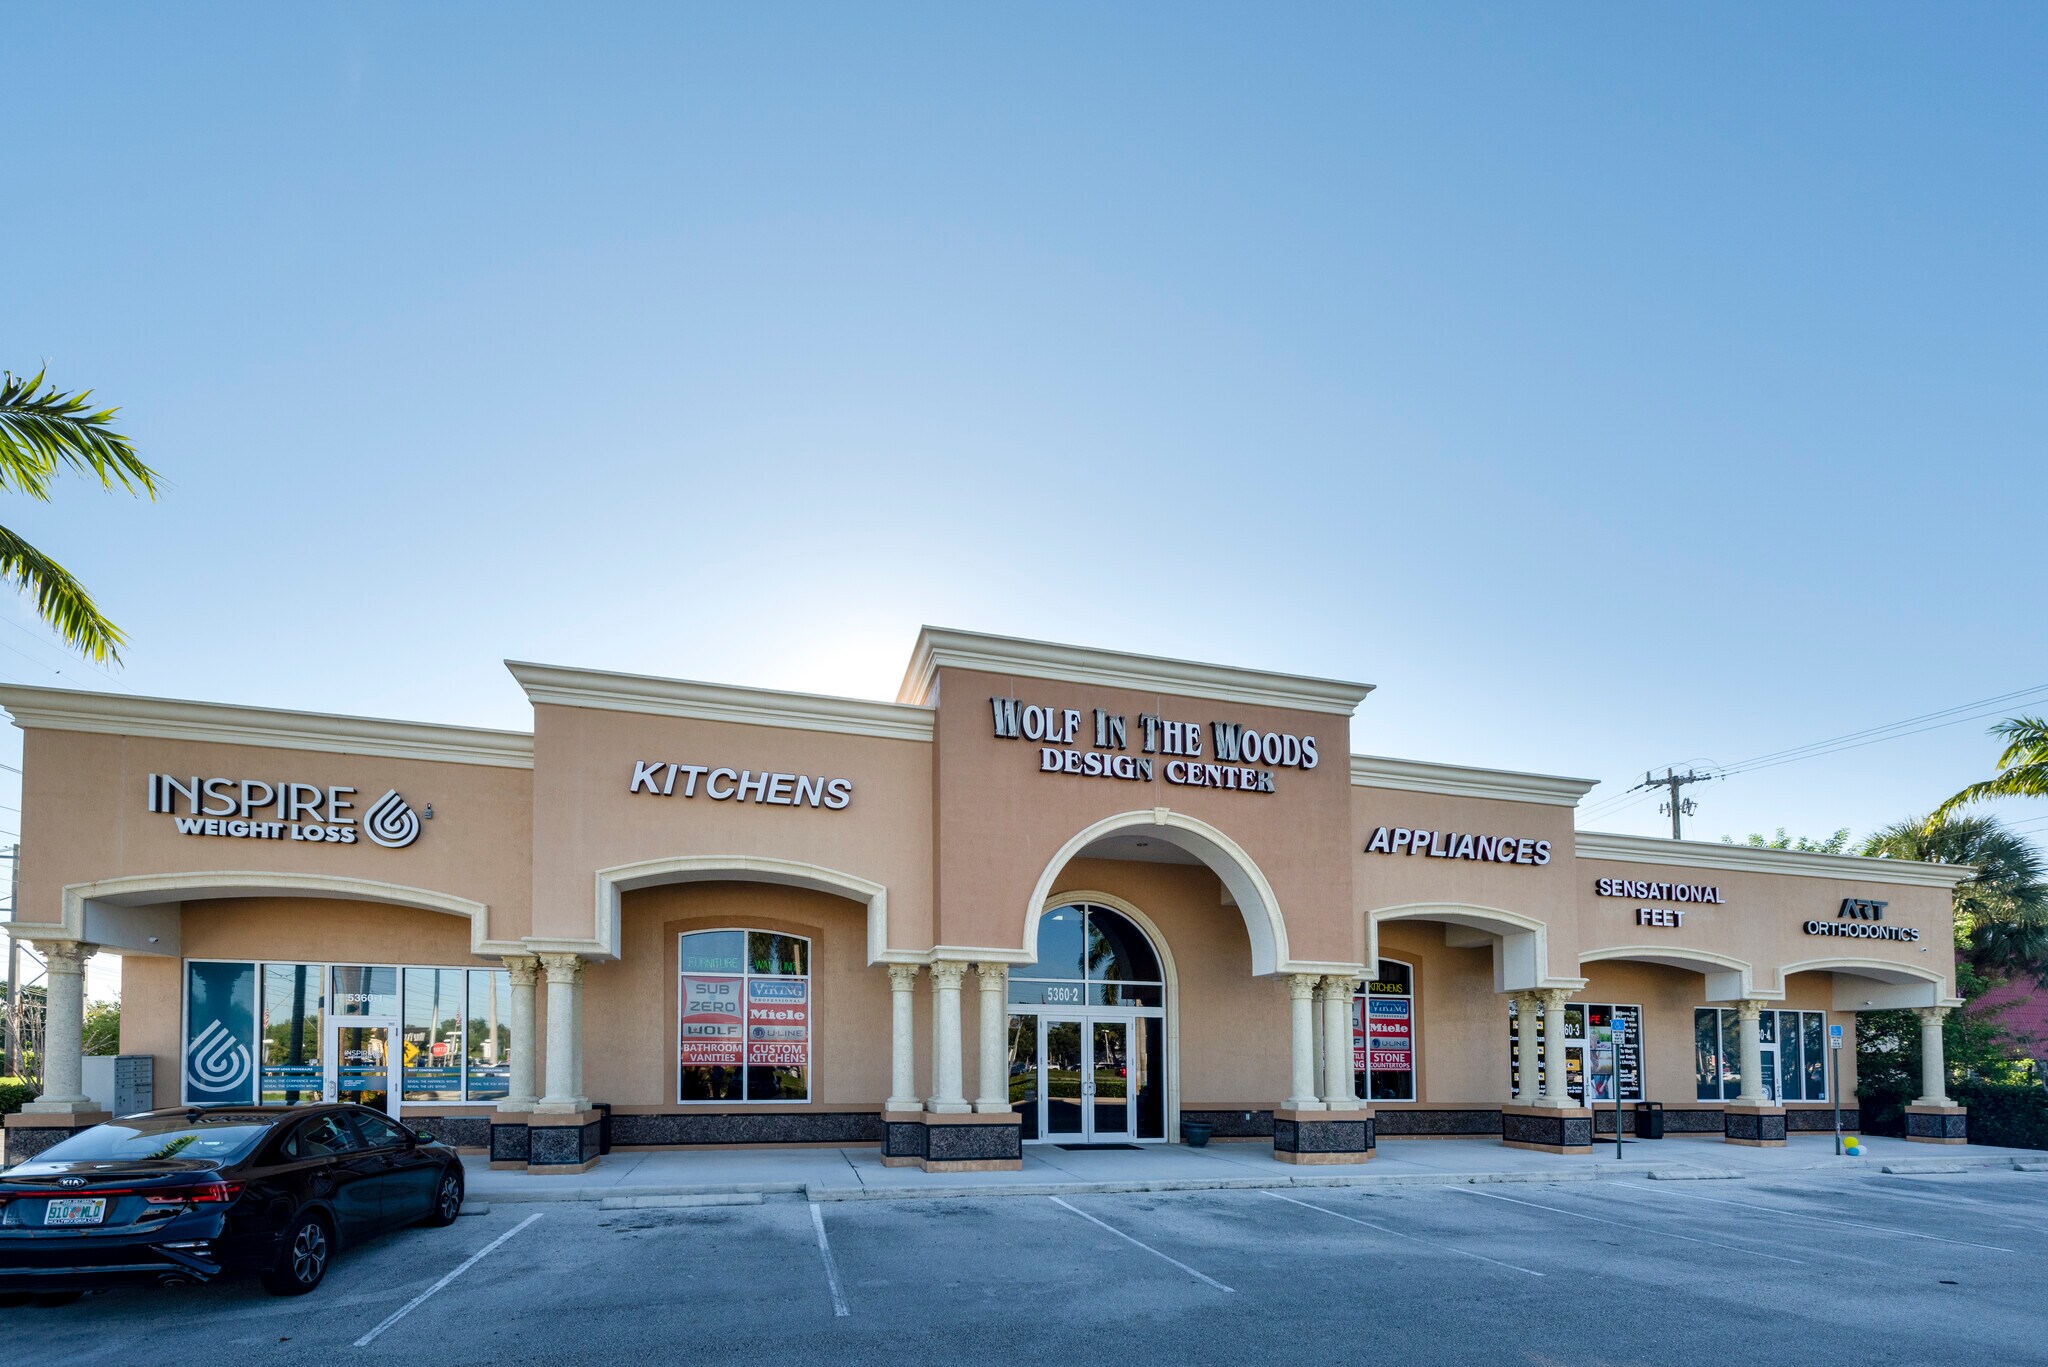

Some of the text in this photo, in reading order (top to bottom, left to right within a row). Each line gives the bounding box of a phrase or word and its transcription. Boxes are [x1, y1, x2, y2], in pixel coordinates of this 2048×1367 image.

[990, 697, 1319, 770] WOLF IN THE WOODS
[1040, 747, 1276, 794] DESIGN CENTER
[630, 760, 852, 810] KITCHENS
[148, 773, 357, 825] INSPIRE
[174, 816, 358, 844] WEIGHT LOSS
[1366, 826, 1552, 866] APPLIANCES
[1596, 878, 1726, 904] SENSATIONAL
[1838, 898, 1889, 920] ART
[1636, 908, 1685, 928] FEET
[1803, 920, 1920, 941] ORTHODONTICS
[696, 984, 729, 994] SUB
[754, 982, 803, 996] VIKING
[1369, 982, 1403, 993] KITCHENS
[1047, 987, 1079, 1002] 5360-2
[690, 1001, 736, 1012] ZERO
[1371, 1002, 1406, 1013] VIKING
[750, 1009, 805, 1020] Miele
[688, 1025, 738, 1035] WOLF
[1370, 1023, 1408, 1033] Miele
[1564, 1023, 1581, 1036] 60-3
[683, 1043, 742, 1052] BATHROOM
[753, 1044, 802, 1054] CUSTOM
[690, 1053, 736, 1062] VANITIES
[749, 1053, 806, 1063] KITCHENS
[1374, 1053, 1405, 1062] STONE
